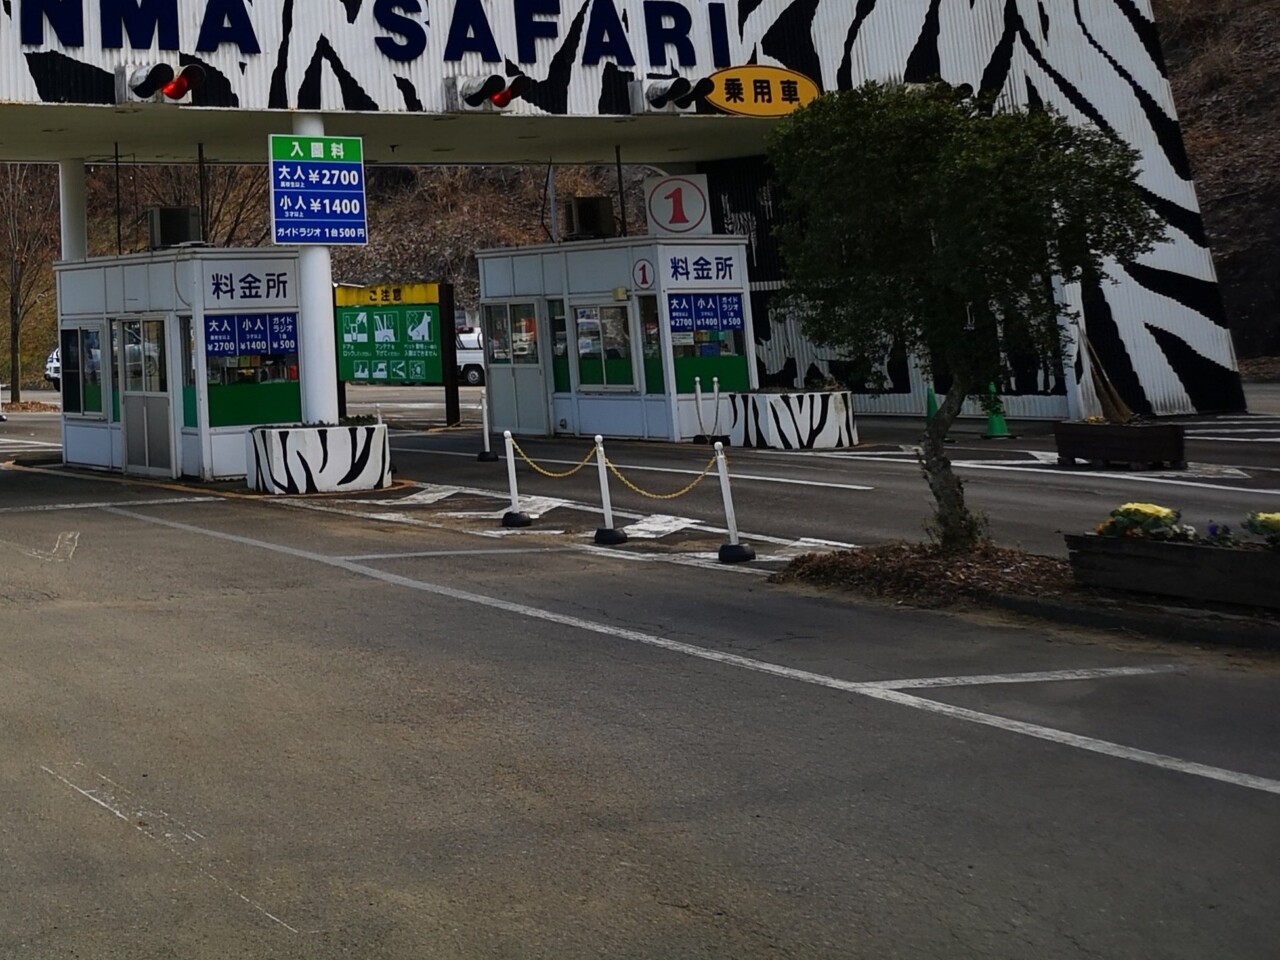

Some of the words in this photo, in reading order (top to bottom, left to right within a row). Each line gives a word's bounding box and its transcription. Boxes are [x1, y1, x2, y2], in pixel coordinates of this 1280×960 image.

[724, 78, 800, 104] 乗用車
[290, 141, 344, 159] 入園料
[278, 165, 305, 180] 大人
[308, 169, 359, 185] ¥2700
[280, 195, 307, 210] 小人
[310, 198, 360, 214] ¥1400
[664, 187, 689, 224] 1
[277, 227, 321, 237] ガイドラジオ
[639, 264, 649, 285] 1
[670, 256, 733, 281] 料金所
[212, 272, 288, 300] 料金所
[670, 298, 689, 309] 大人
[697, 298, 715, 309] 小人
[209, 320, 231, 332] 大人
[242, 318, 264, 331] 小人
[273, 316, 293, 324] ガイド
[207, 342, 235, 351] ¥2700
[240, 341, 267, 350] ¥1400
